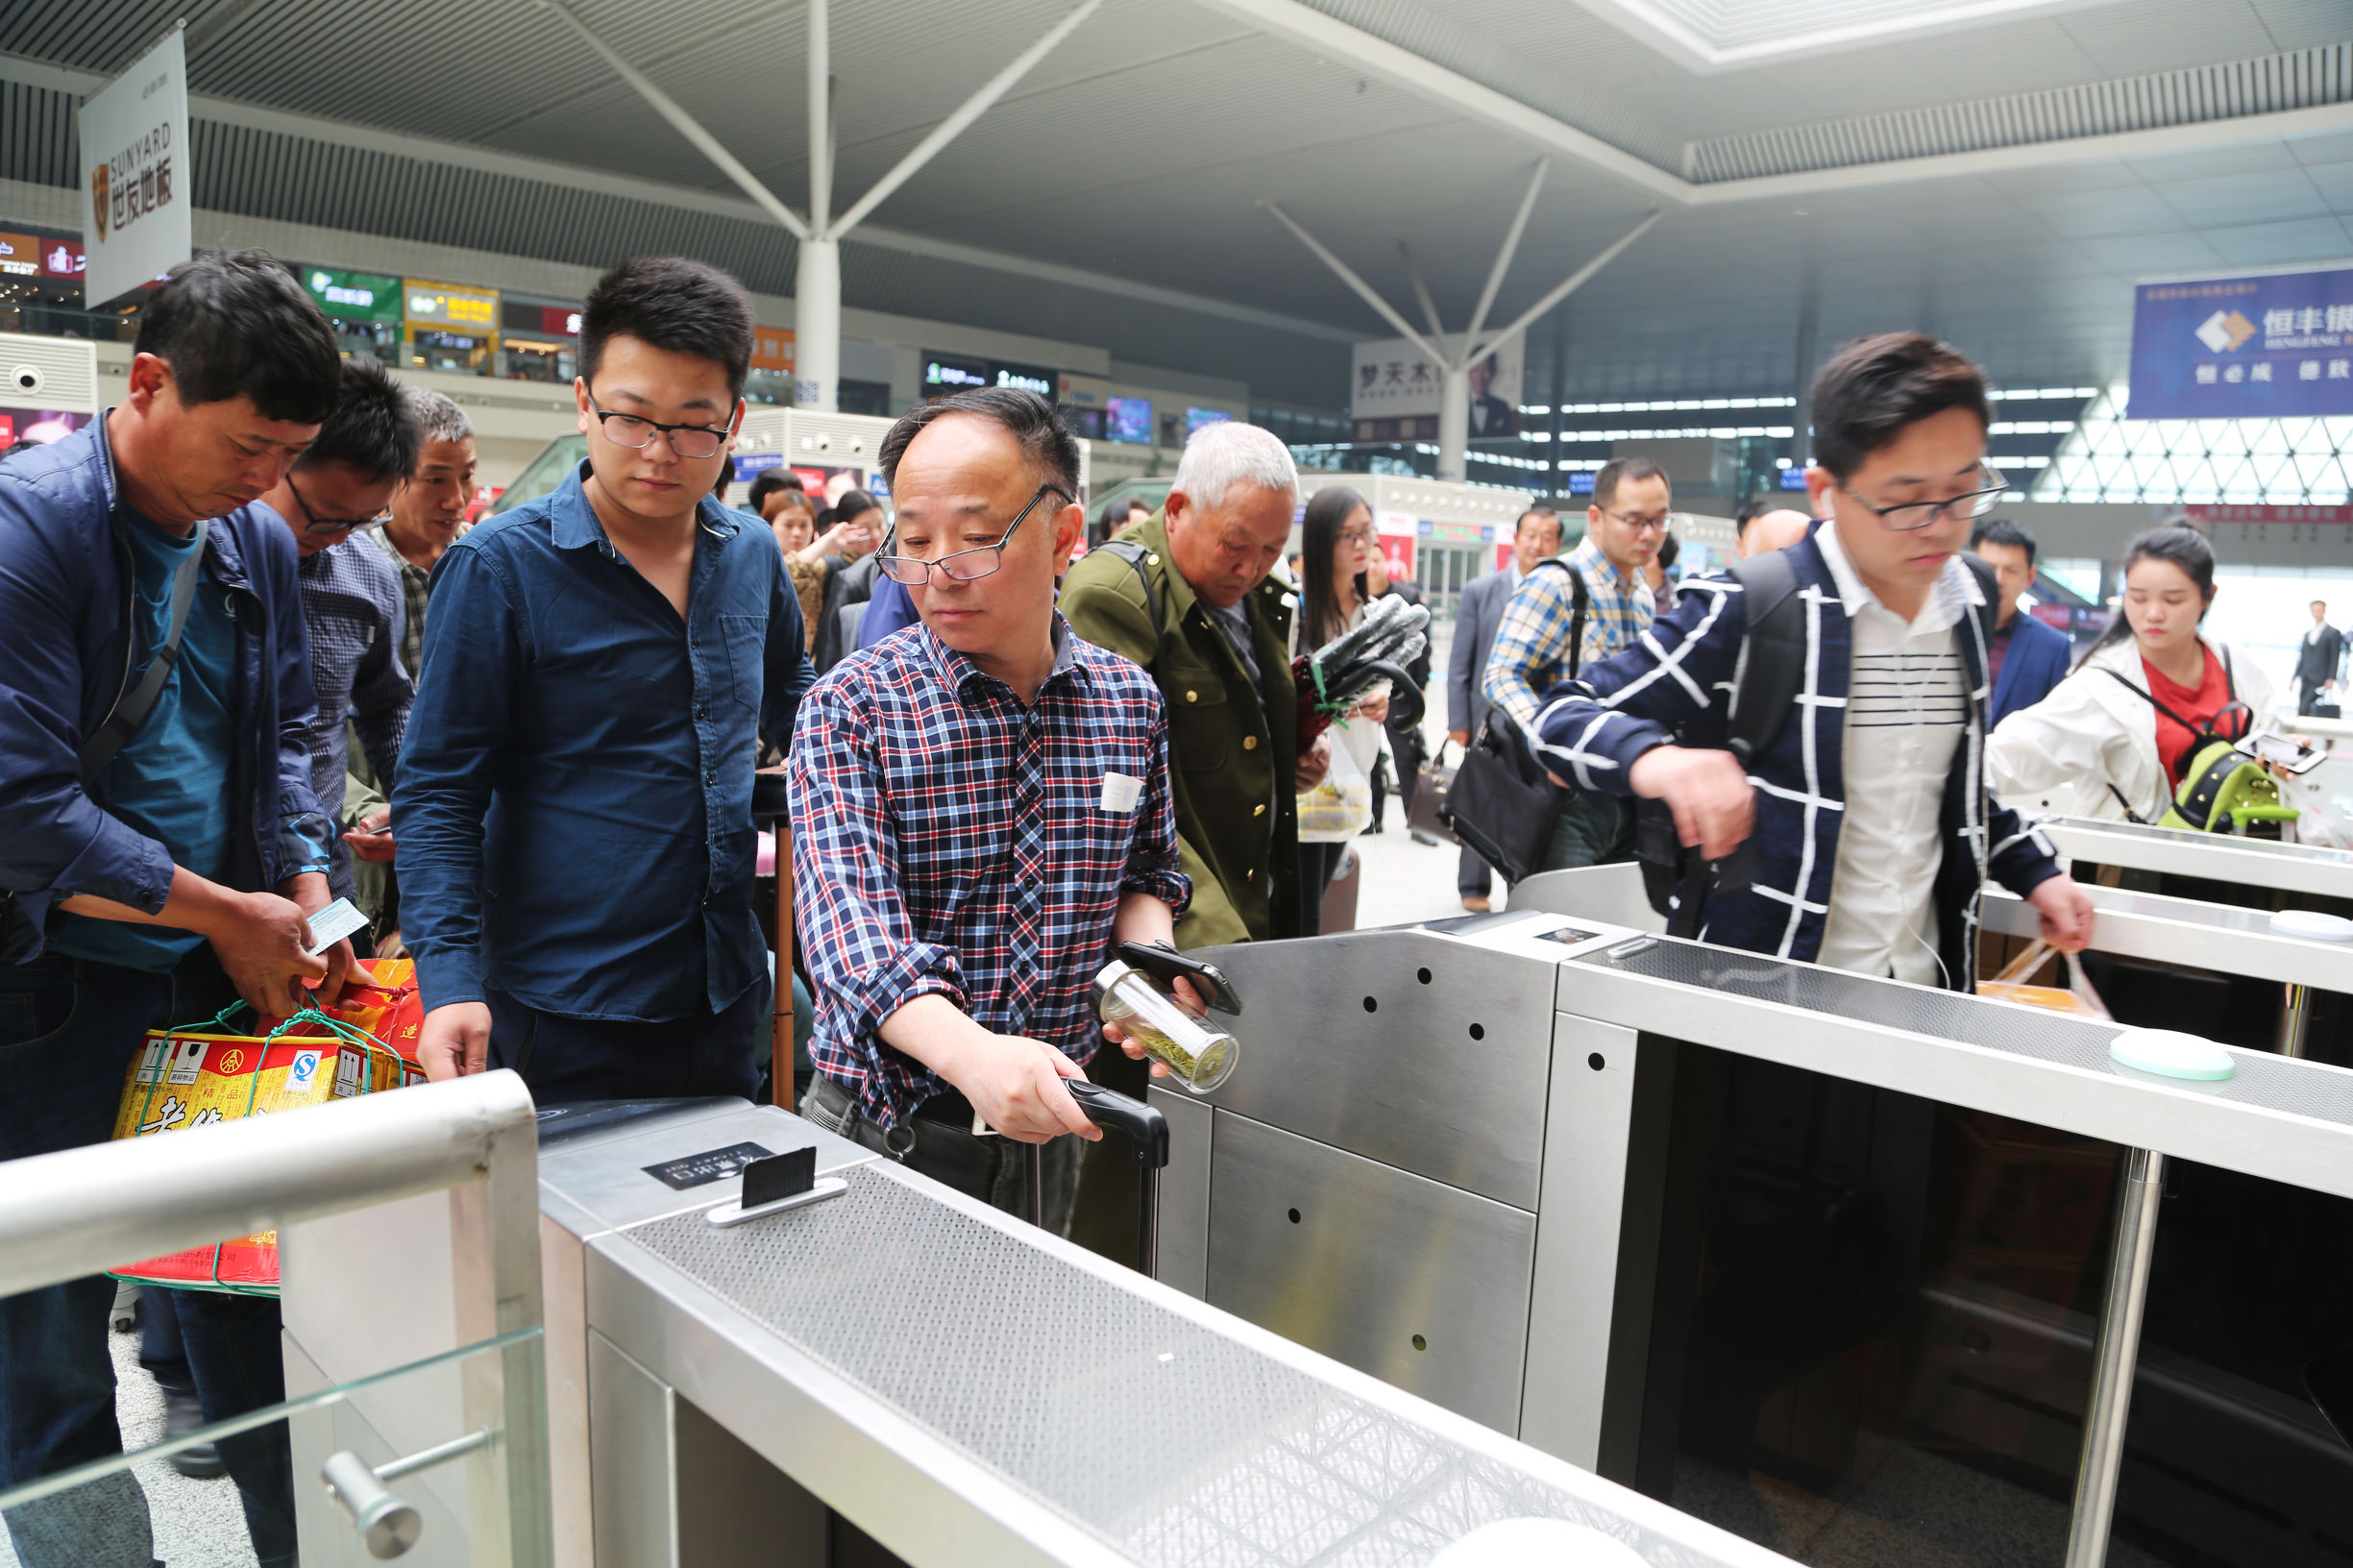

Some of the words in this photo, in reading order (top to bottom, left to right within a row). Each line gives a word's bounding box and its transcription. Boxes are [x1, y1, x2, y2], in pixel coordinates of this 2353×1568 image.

[110, 122, 171, 183] SUNYARD
[111, 157, 173, 231] 世友地板
[1360, 361, 1441, 388] 梦天木
[400, 1023, 417, 1039] 造
